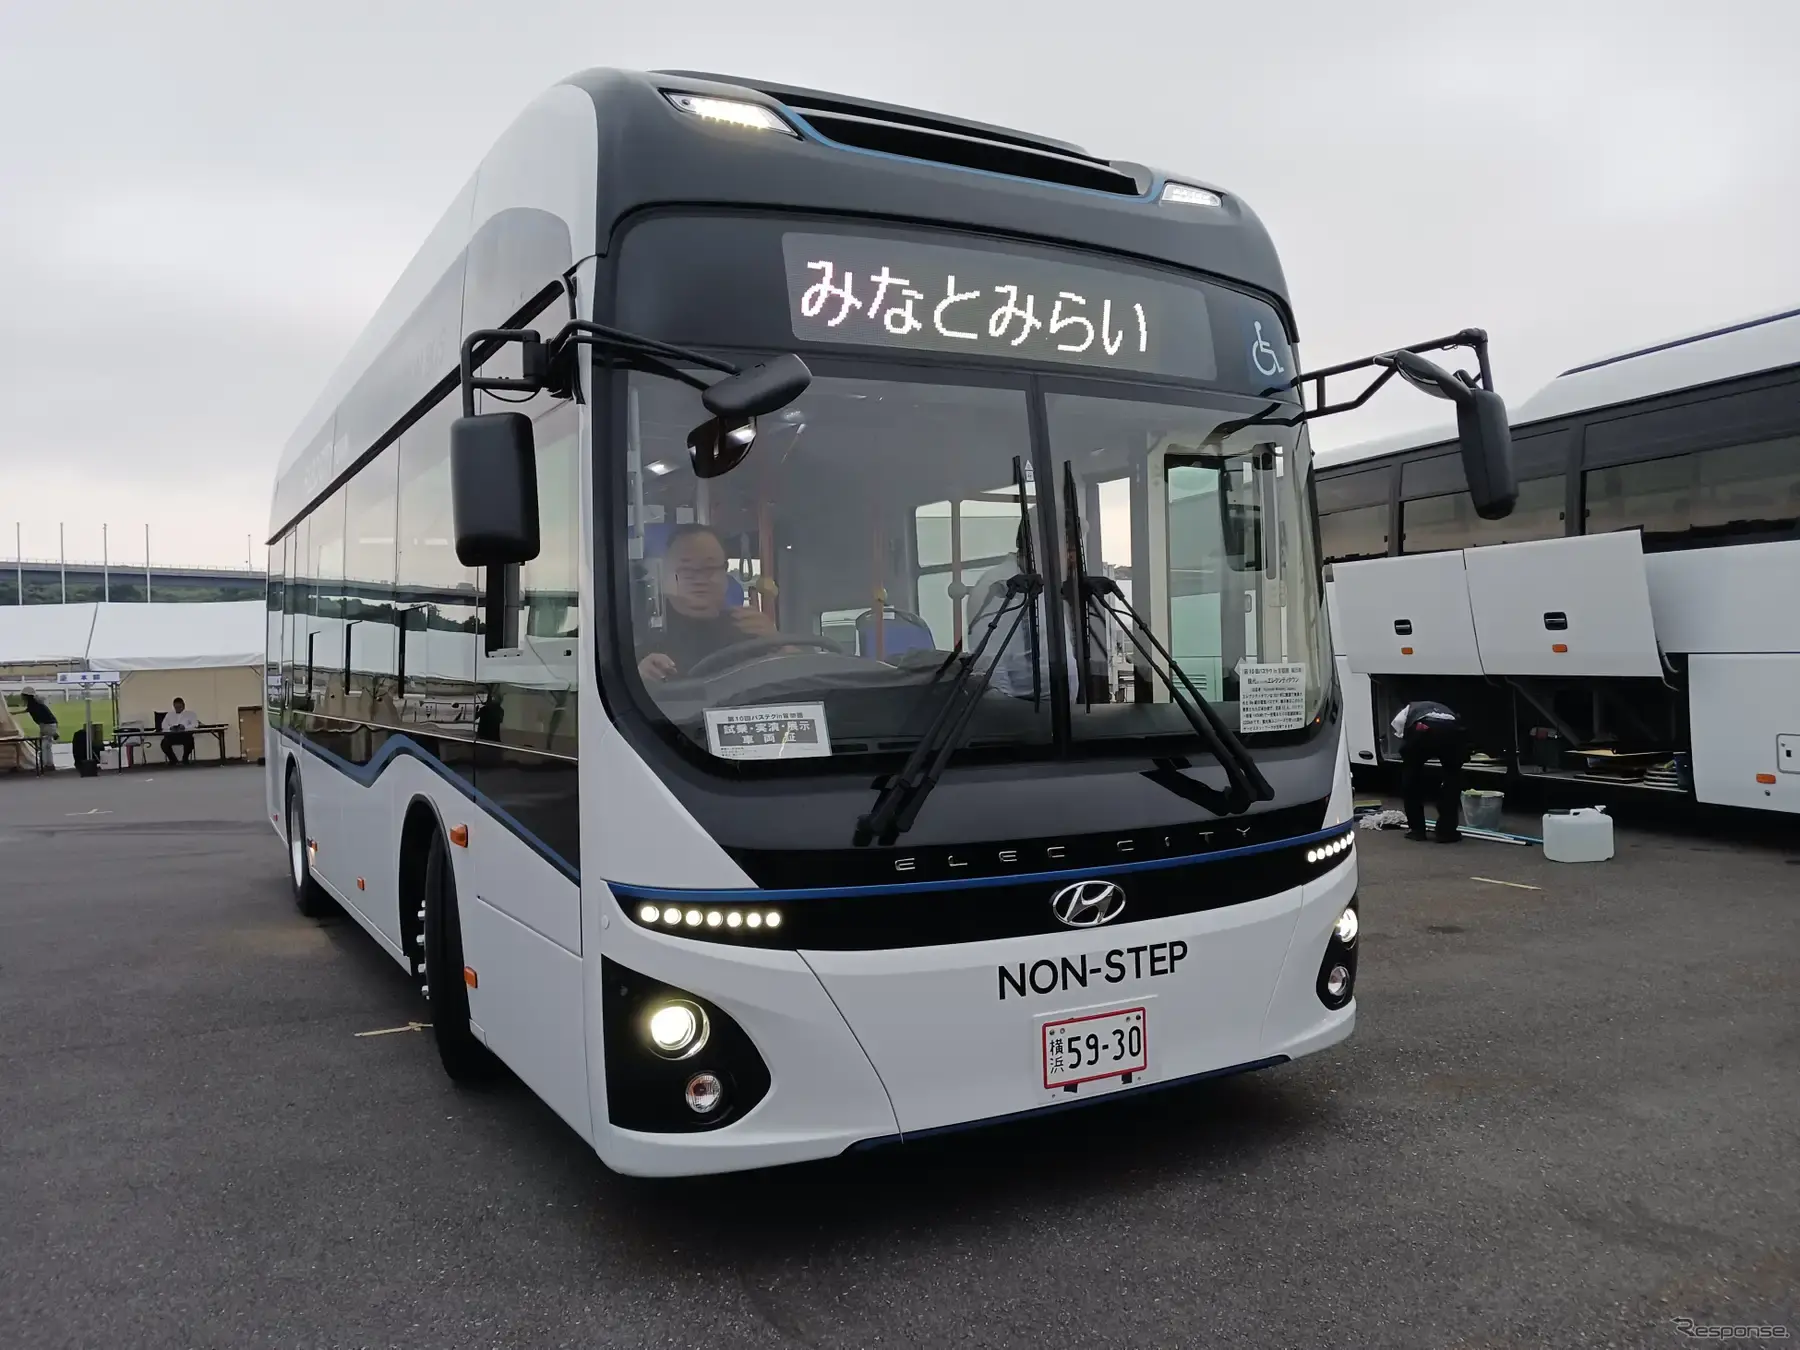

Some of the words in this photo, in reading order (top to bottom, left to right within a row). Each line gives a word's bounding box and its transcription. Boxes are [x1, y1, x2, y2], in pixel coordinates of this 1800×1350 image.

[800, 260, 1148, 356] みなとみらい
[894, 845, 1066, 871] ELEC
[1116, 826, 1251, 852] CITY
[998, 939, 1188, 1000] NON-STEP
[1049, 1038, 1064, 1074] 横浜
[1067, 1025, 1142, 1070] 59-30
